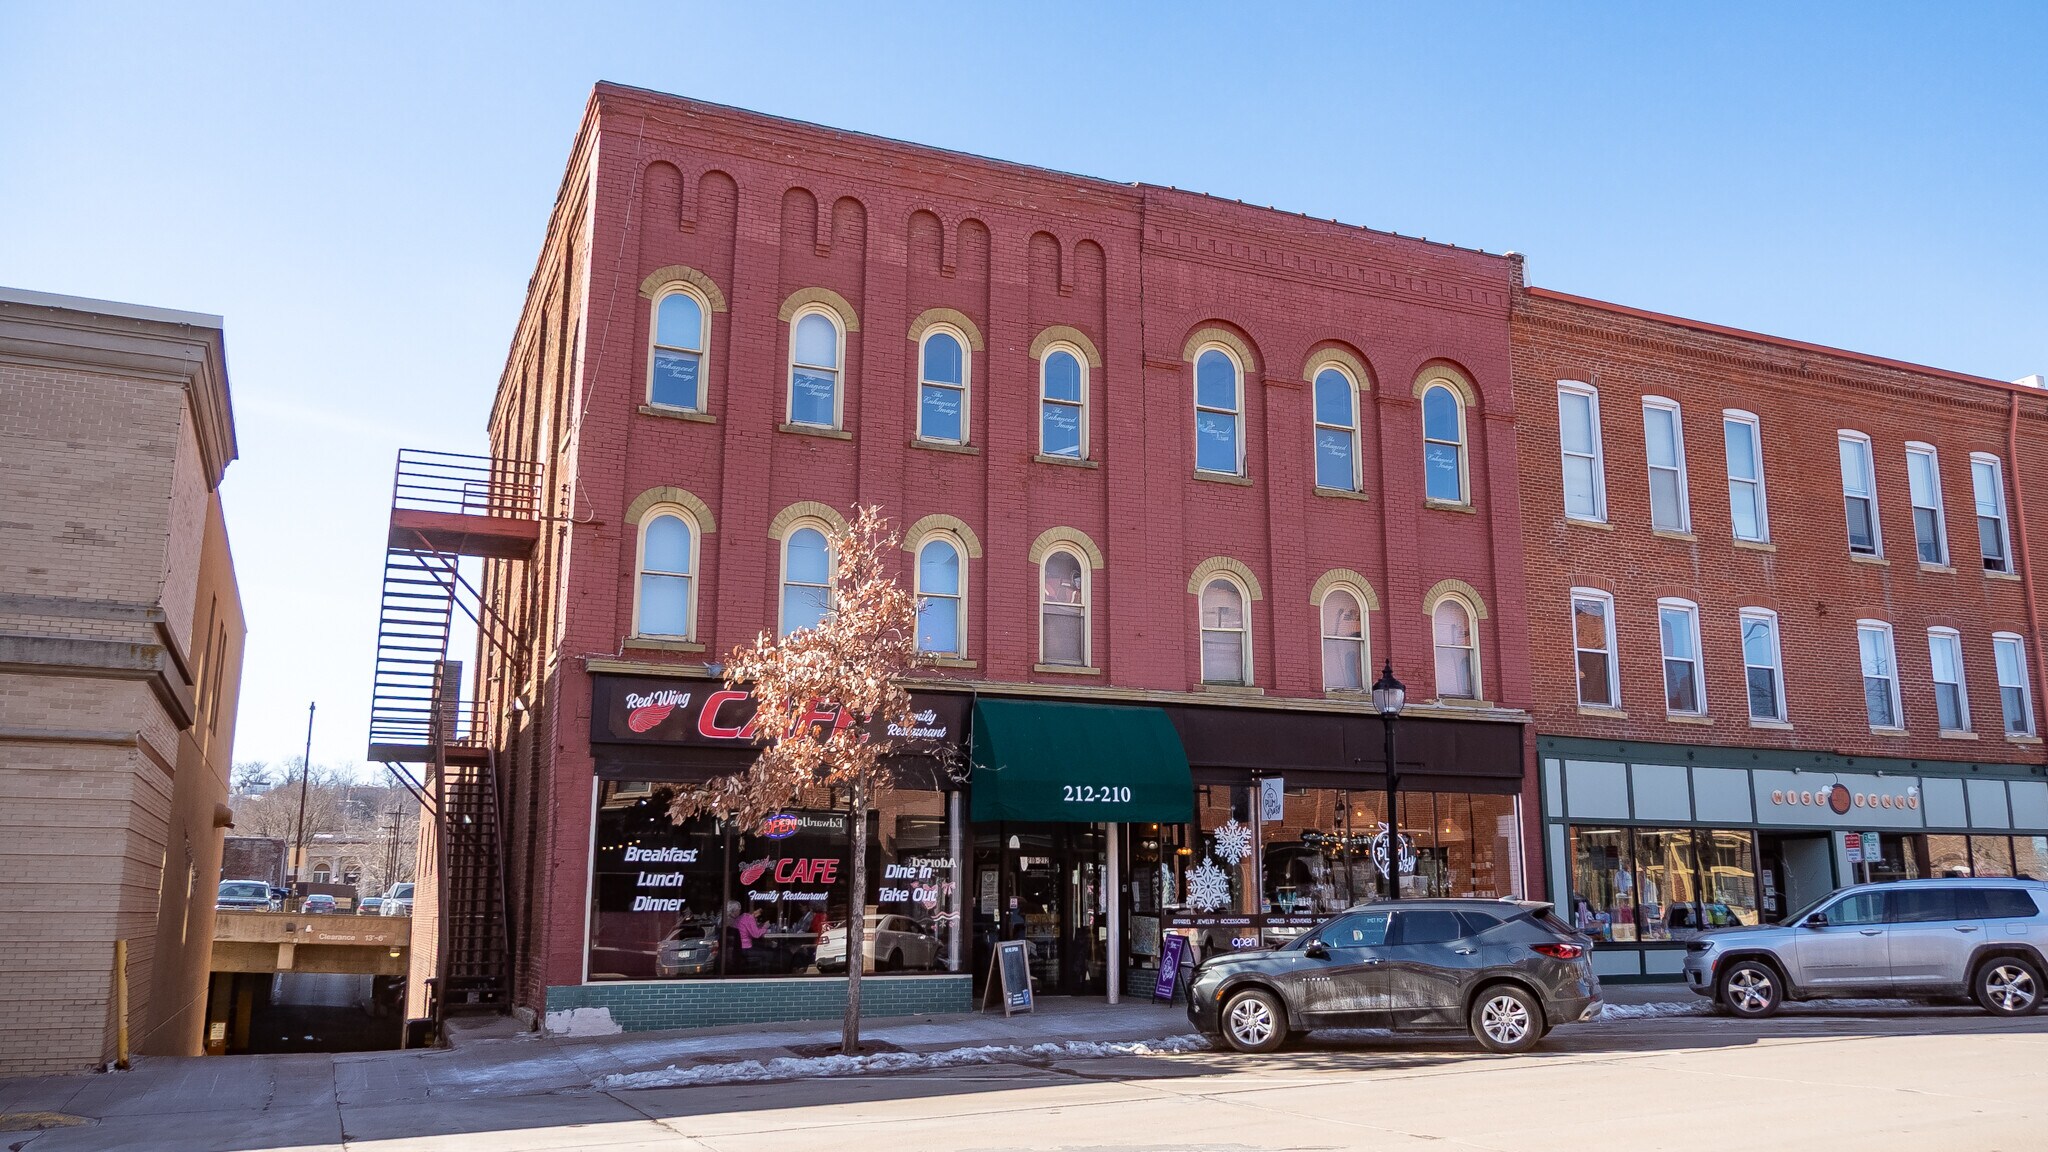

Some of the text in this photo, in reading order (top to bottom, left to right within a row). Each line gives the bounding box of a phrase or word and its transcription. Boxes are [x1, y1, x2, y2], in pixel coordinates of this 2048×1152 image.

[625, 689, 691, 709] Red Wing
[899, 709, 937, 725] mily
[1063, 785, 1131, 802] 212-210
[1772, 791, 1918, 808] WISE PENNY
[624, 846, 698, 862] Breakfast
[1377, 846, 1404, 860] PLM
[774, 858, 840, 884] CAFE
[885, 864, 933, 878] Dine In
[637, 871, 684, 887] Lunch
[748, 890, 829, 903] Family Restaurant
[878, 887, 937, 902] Take Out
[633, 896, 685, 911] Dinner
[318, 933, 356, 941] Clearance
[1231, 937, 1257, 948] open
